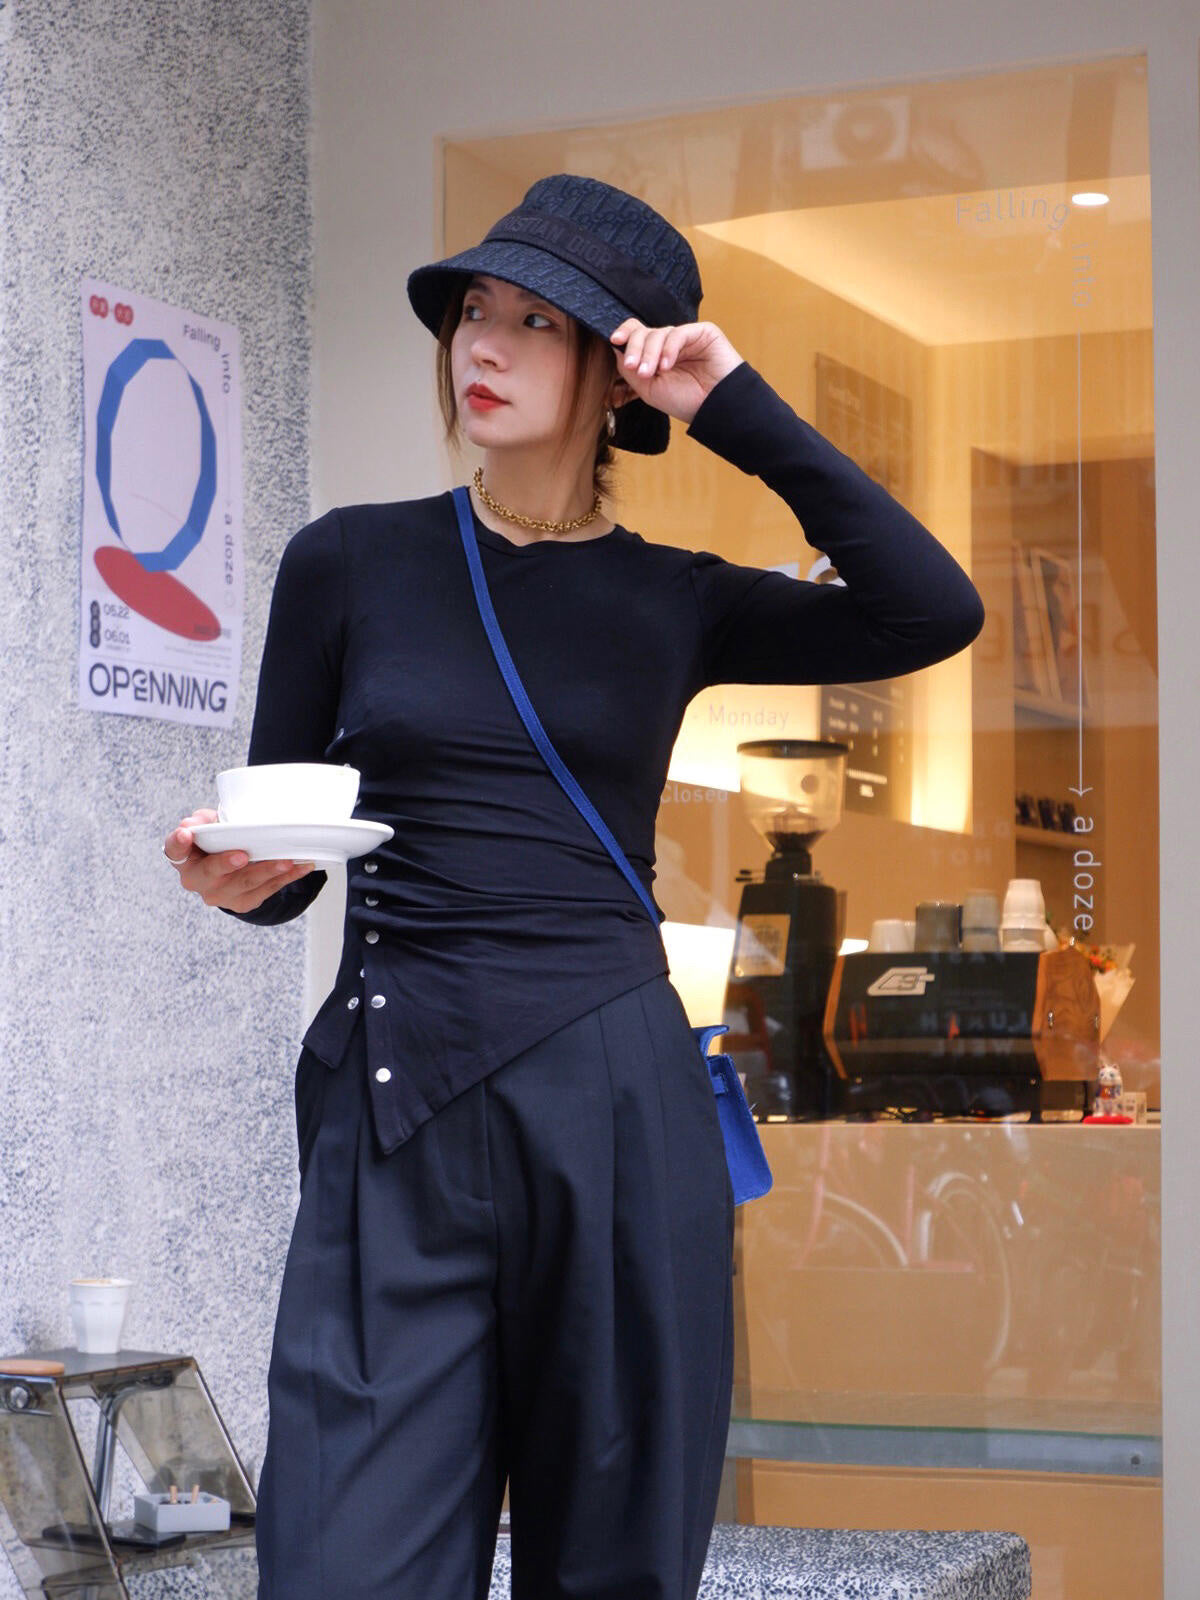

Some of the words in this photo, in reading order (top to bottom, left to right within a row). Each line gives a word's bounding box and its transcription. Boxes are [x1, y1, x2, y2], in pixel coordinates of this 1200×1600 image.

[956, 191, 1071, 231] Falling
[1072, 241, 1095, 307] into
[183, 324, 221, 352] Falling
[221, 353, 232, 394] into
[224, 514, 233, 526] a
[224, 534, 234, 585] doze
[89, 663, 227, 712] OPENNING
[708, 704, 790, 729] Monday
[660, 784, 729, 804] Closed
[1073, 816, 1094, 833] a
[1073, 850, 1101, 931] doze
